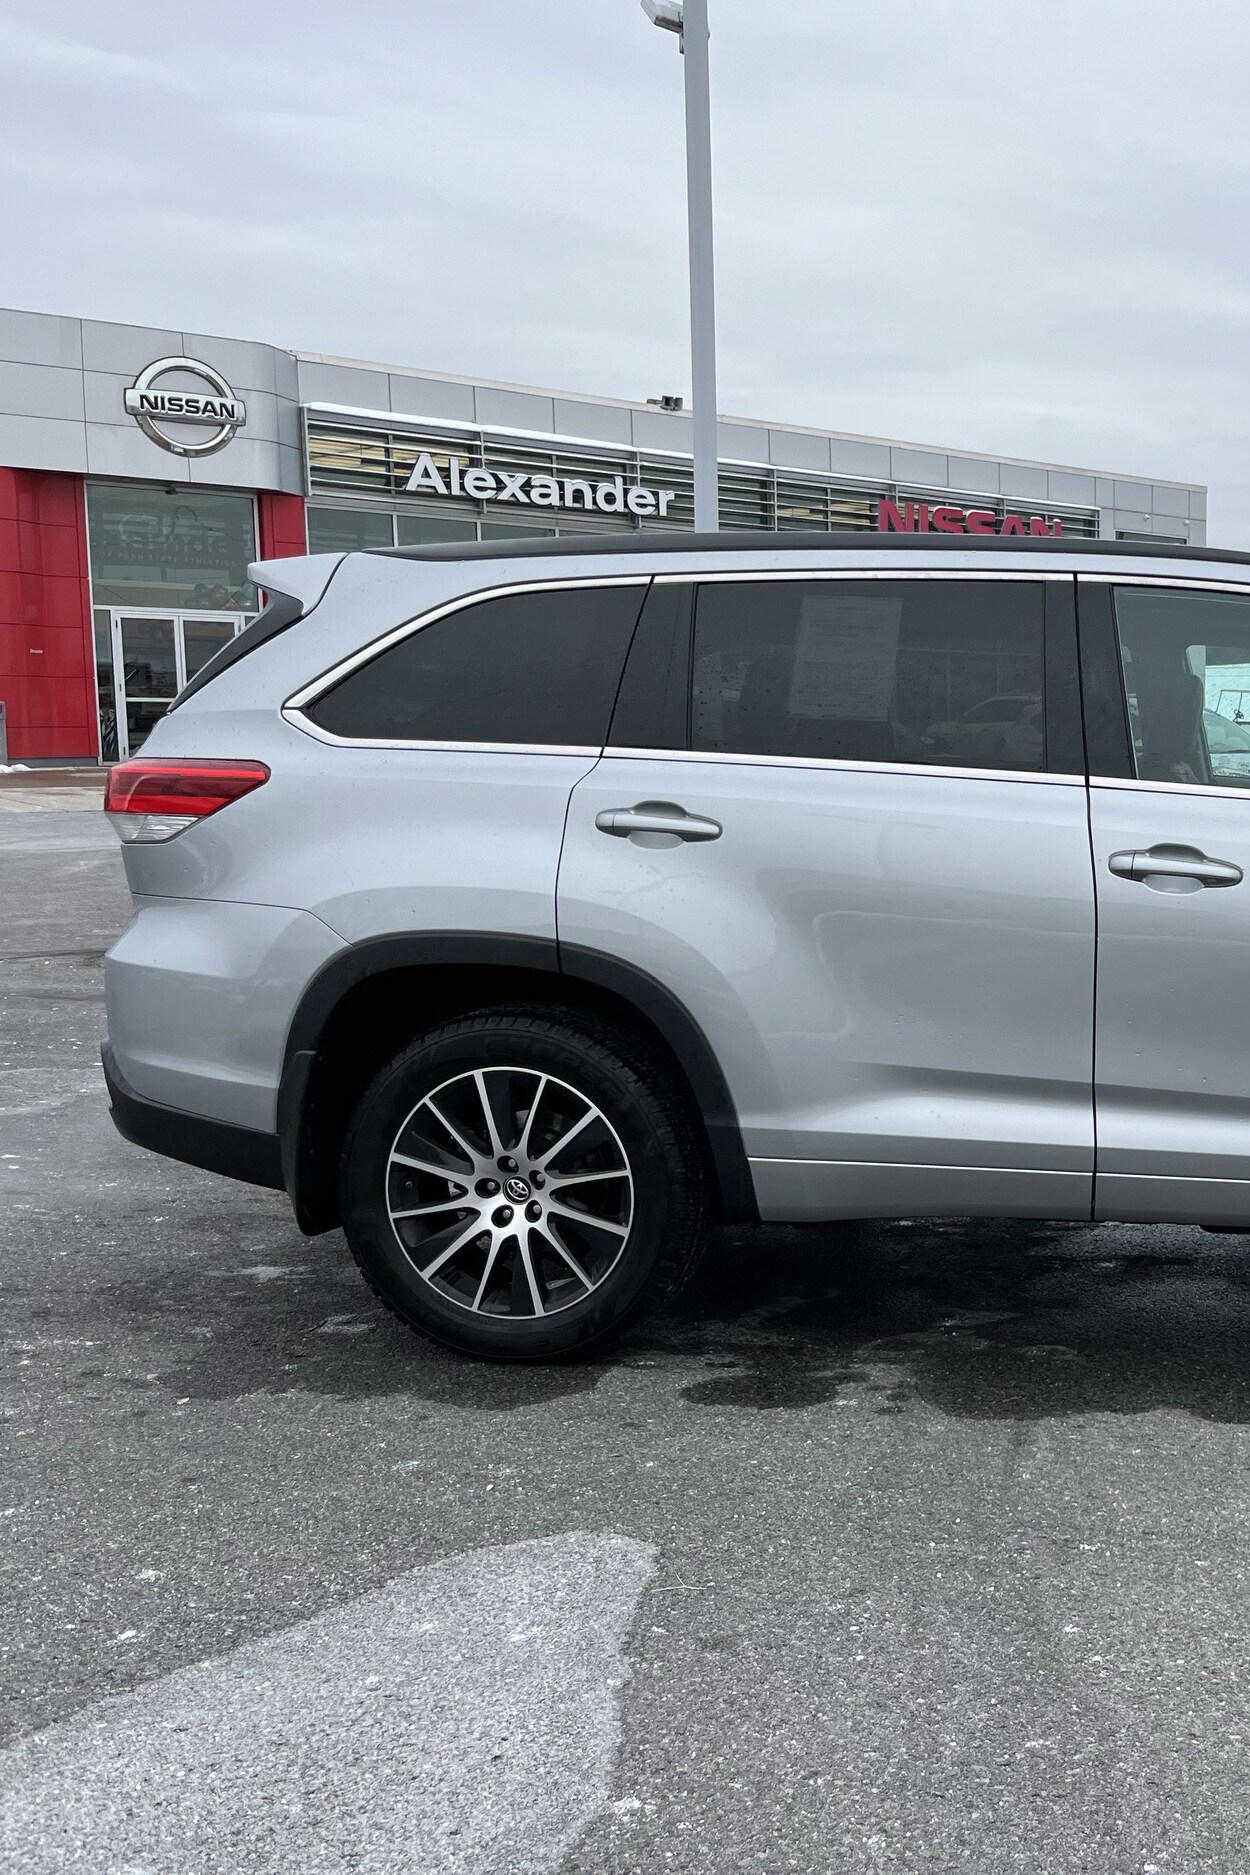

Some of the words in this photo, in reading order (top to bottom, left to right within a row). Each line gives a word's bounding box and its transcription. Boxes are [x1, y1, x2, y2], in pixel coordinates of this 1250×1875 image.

[139, 393, 236, 420] NISSAN
[405, 452, 676, 517] Alexander
[878, 498, 1063, 537] NISSAN
[183, 557, 237, 568] ATHLETICS
